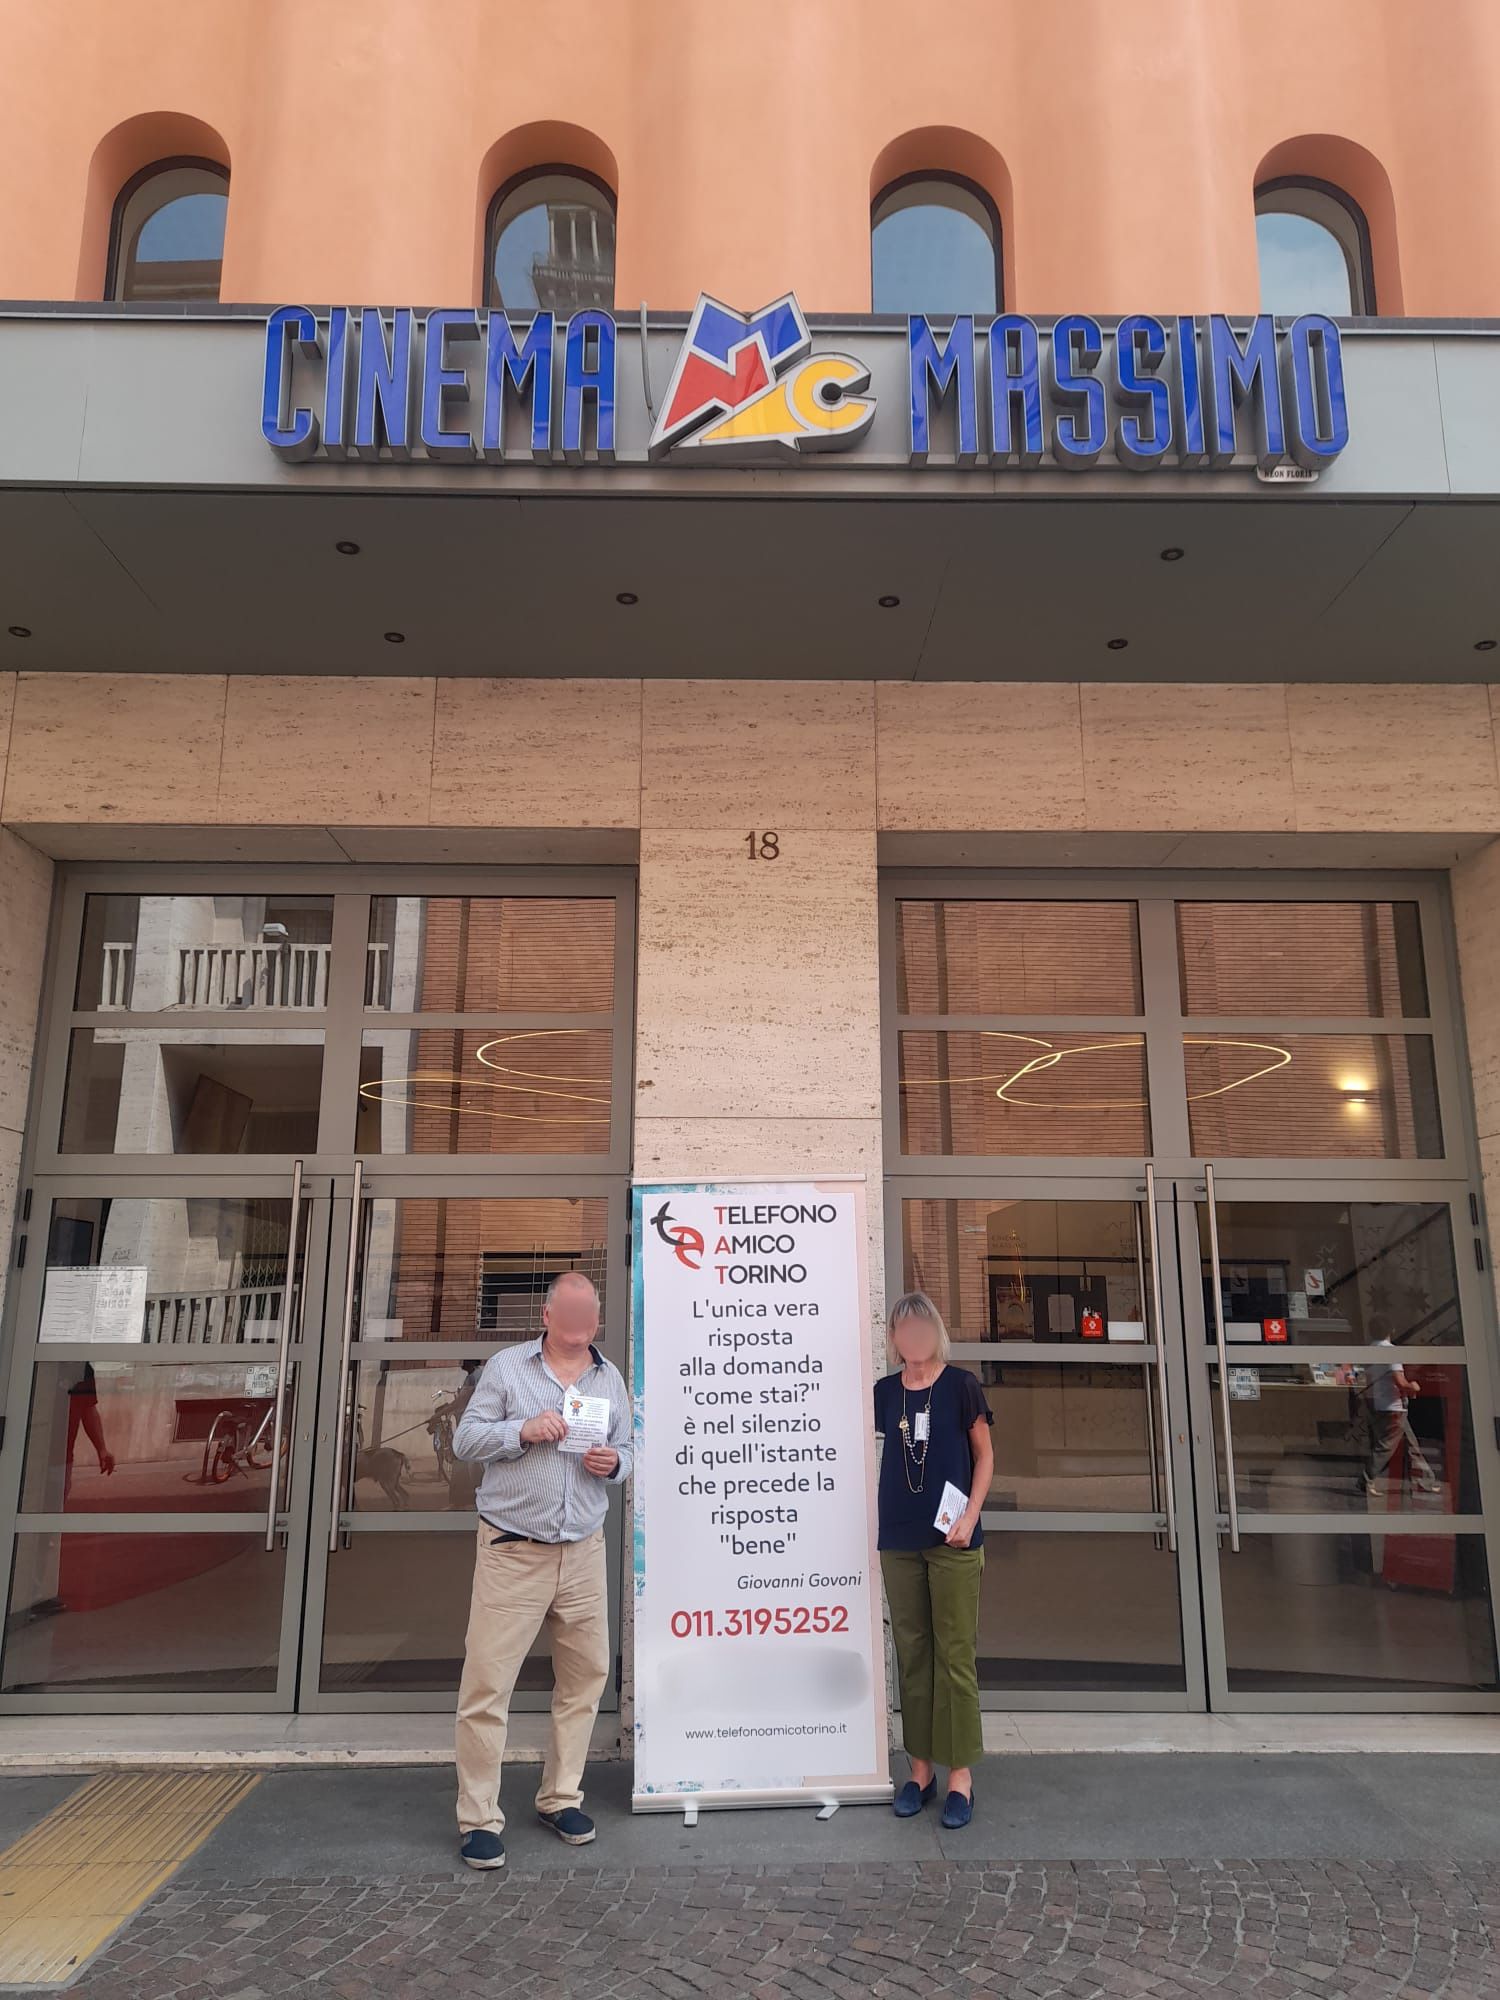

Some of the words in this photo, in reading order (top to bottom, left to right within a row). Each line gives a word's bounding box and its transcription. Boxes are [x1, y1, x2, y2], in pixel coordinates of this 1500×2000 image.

[260, 305, 618, 458] CINEMA
[907, 312, 1349, 462] MASSIMO
[744, 830, 780, 860] 18
[713, 1204, 837, 1225] TELEFONO
[713, 1234, 795, 1255] AMICO
[713, 1264, 807, 1285] TORINO
[692, 1299, 767, 1318] L'unica
[774, 1302, 819, 1317] vera
[708, 1328, 793, 1352] risposta
[679, 1357, 715, 1376] alla
[723, 1354, 823, 1376] domanda
[683, 1385, 752, 1405] "come
[760, 1382, 820, 1403] stai?"
[683, 1416, 696, 1436] è
[703, 1414, 734, 1435] nel
[742, 1413, 821, 1433] silenzio
[675, 1445, 694, 1465] di
[701, 1442, 837, 1470] quell'istante
[678, 1475, 716, 1495] che
[724, 1472, 810, 1500] precede
[817, 1470, 835, 1491] la
[711, 1505, 798, 1530] risposta
[720, 1533, 796, 1555] "bene"
[737, 1573, 804, 1589] Giovanni
[808, 1571, 862, 1588] Govoni
[671, 1606, 849, 1638] 011.3195252
[685, 1722, 847, 1739] www.telefonoamicotorino.it
